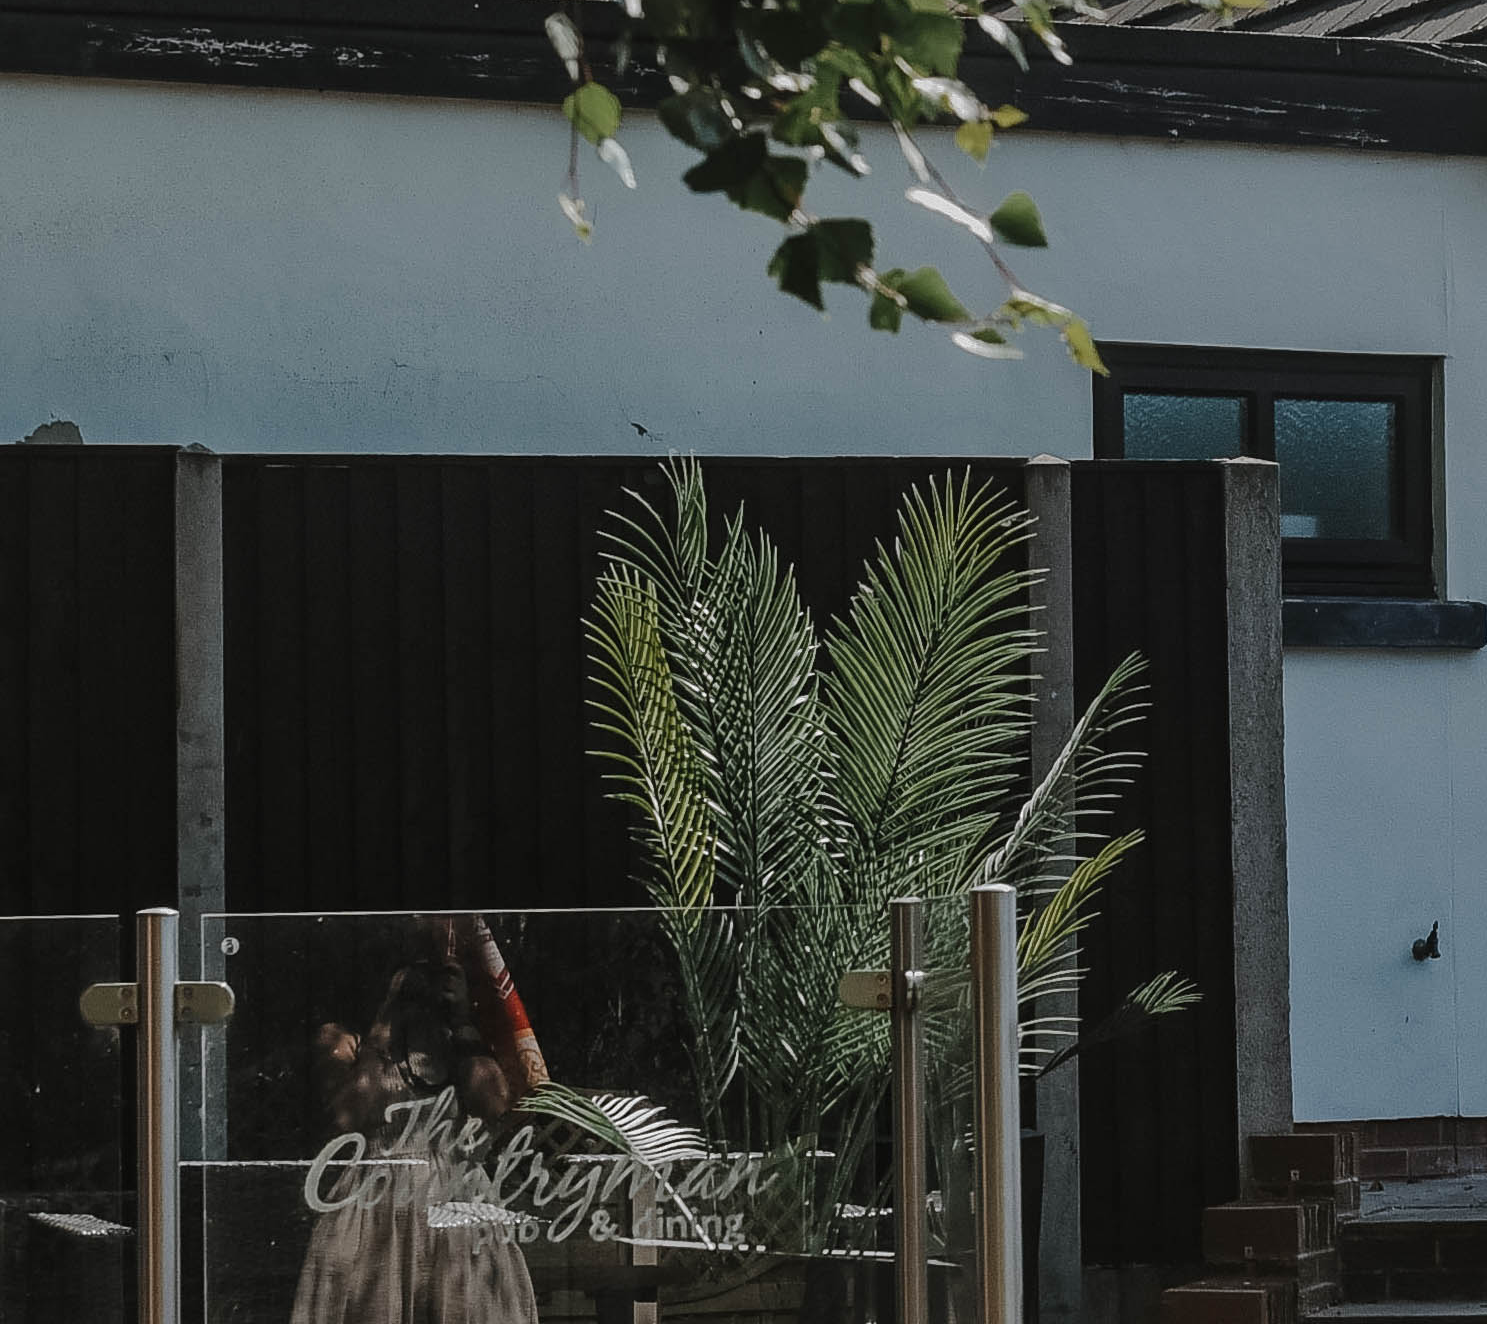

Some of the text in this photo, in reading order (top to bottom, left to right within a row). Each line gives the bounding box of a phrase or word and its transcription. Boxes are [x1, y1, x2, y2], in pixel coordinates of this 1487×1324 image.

[384, 1084, 490, 1157] The
[303, 1124, 779, 1244] Countryman
[589, 1211, 619, 1243] &
[631, 1205, 747, 1246] dining
